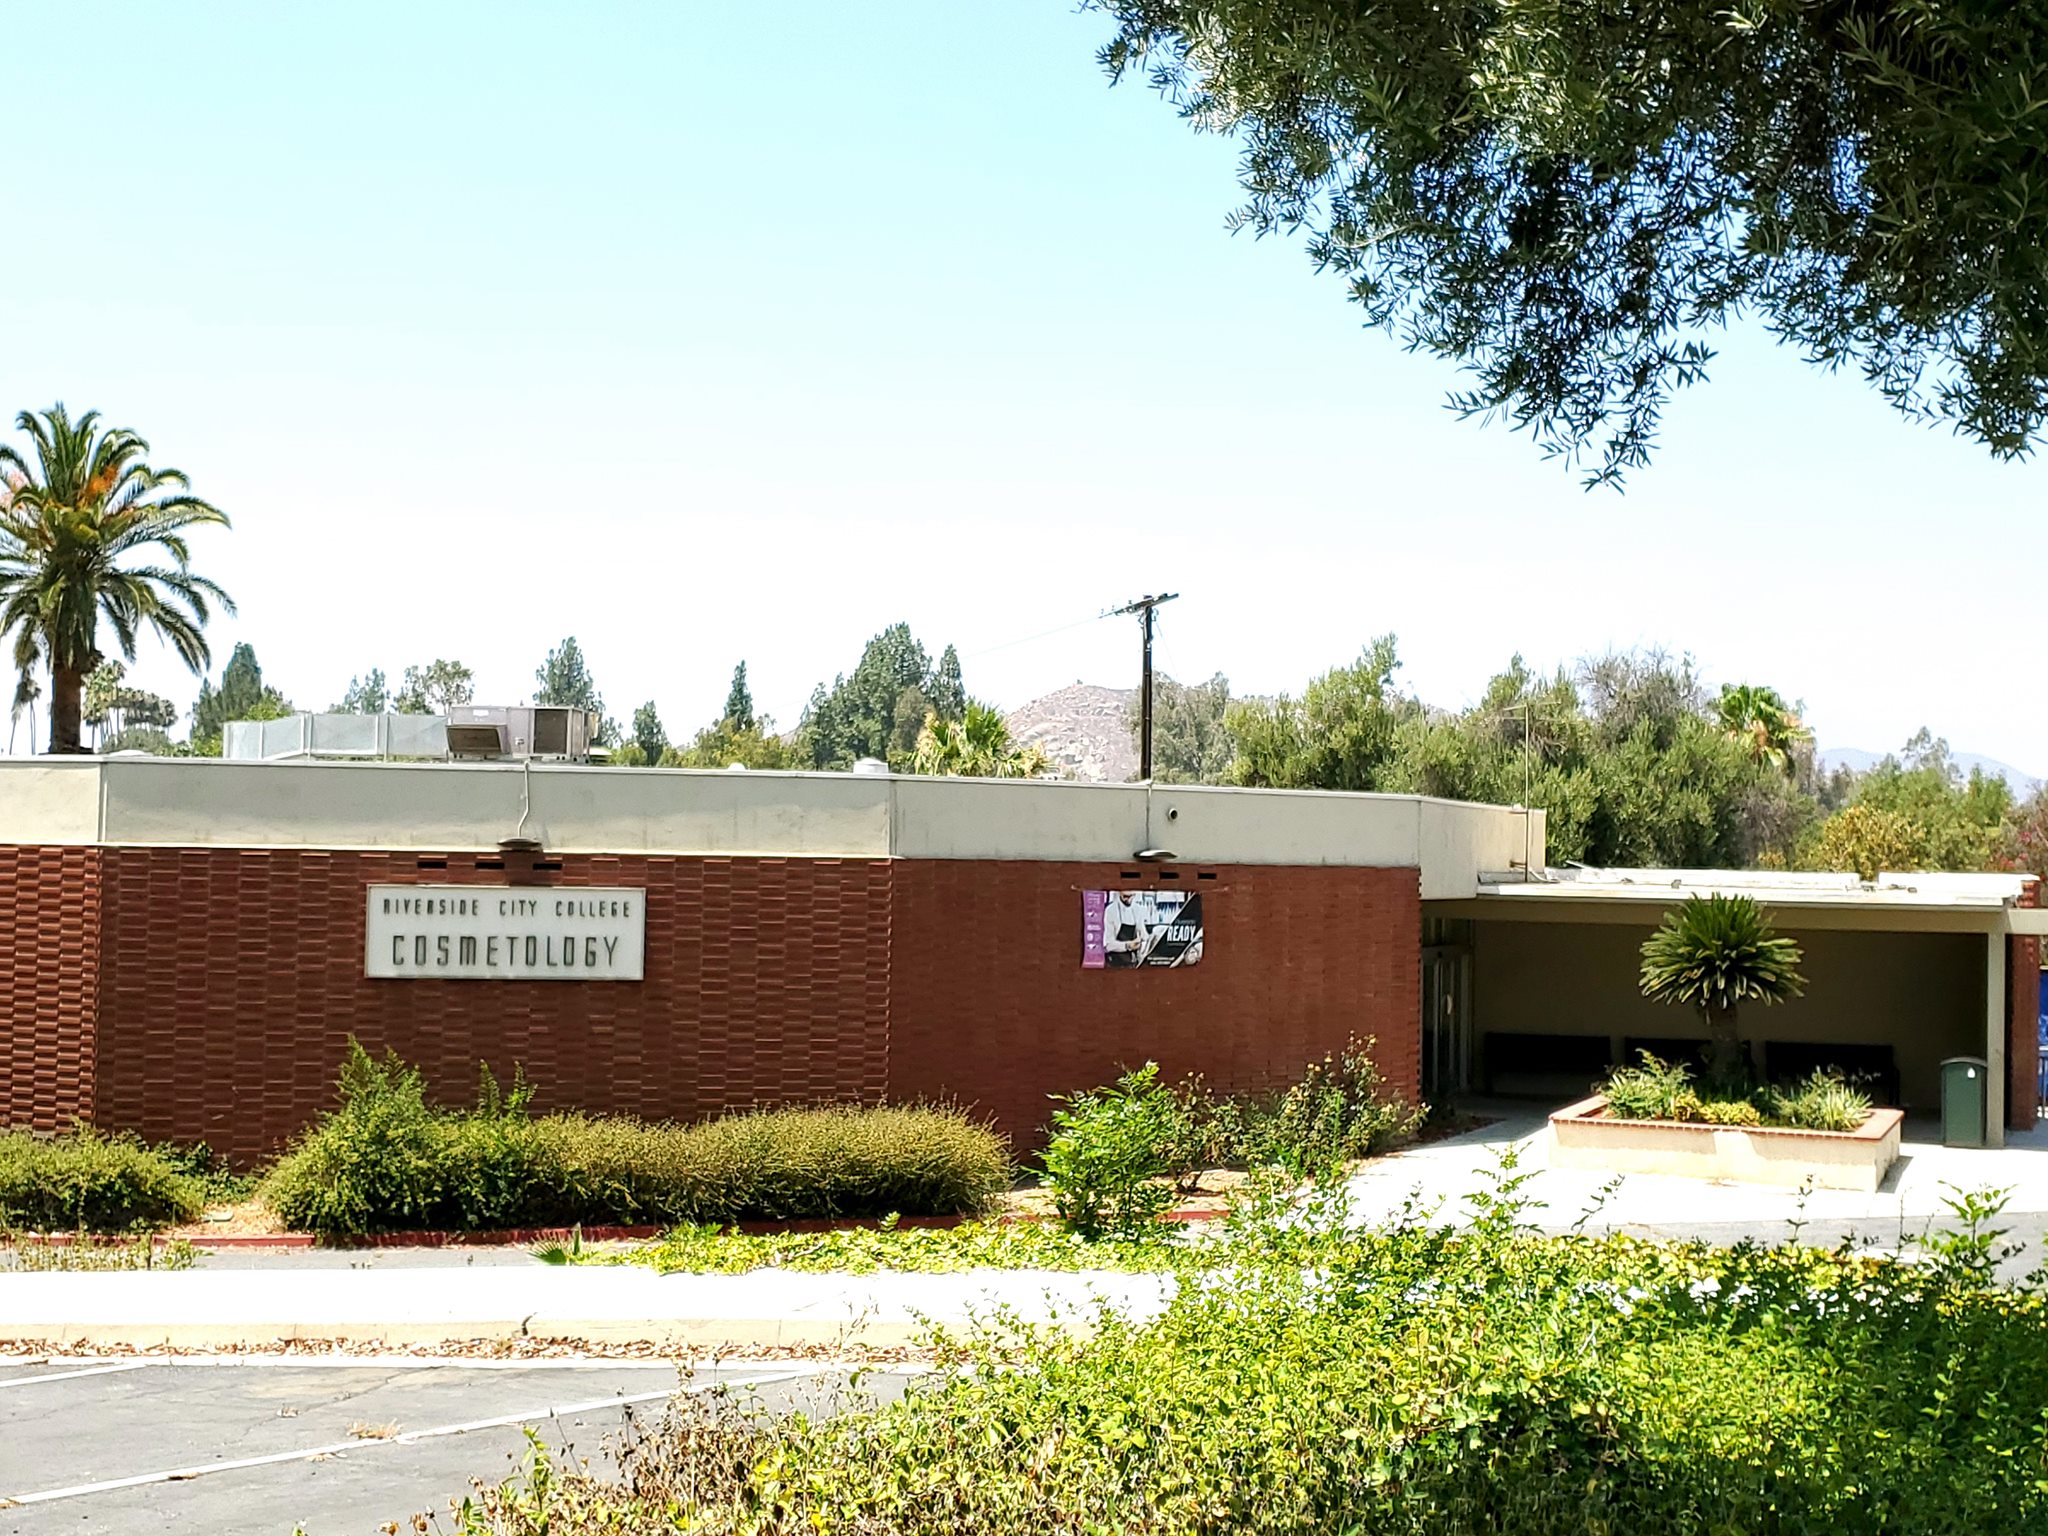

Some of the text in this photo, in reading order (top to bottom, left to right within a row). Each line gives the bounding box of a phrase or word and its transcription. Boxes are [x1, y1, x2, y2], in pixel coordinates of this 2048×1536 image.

[383, 898, 630, 918] RIVERSIDE CITY COLLEGE
[1167, 925, 1196, 942] READY
[393, 935, 618, 967] COSMETOLOGY
